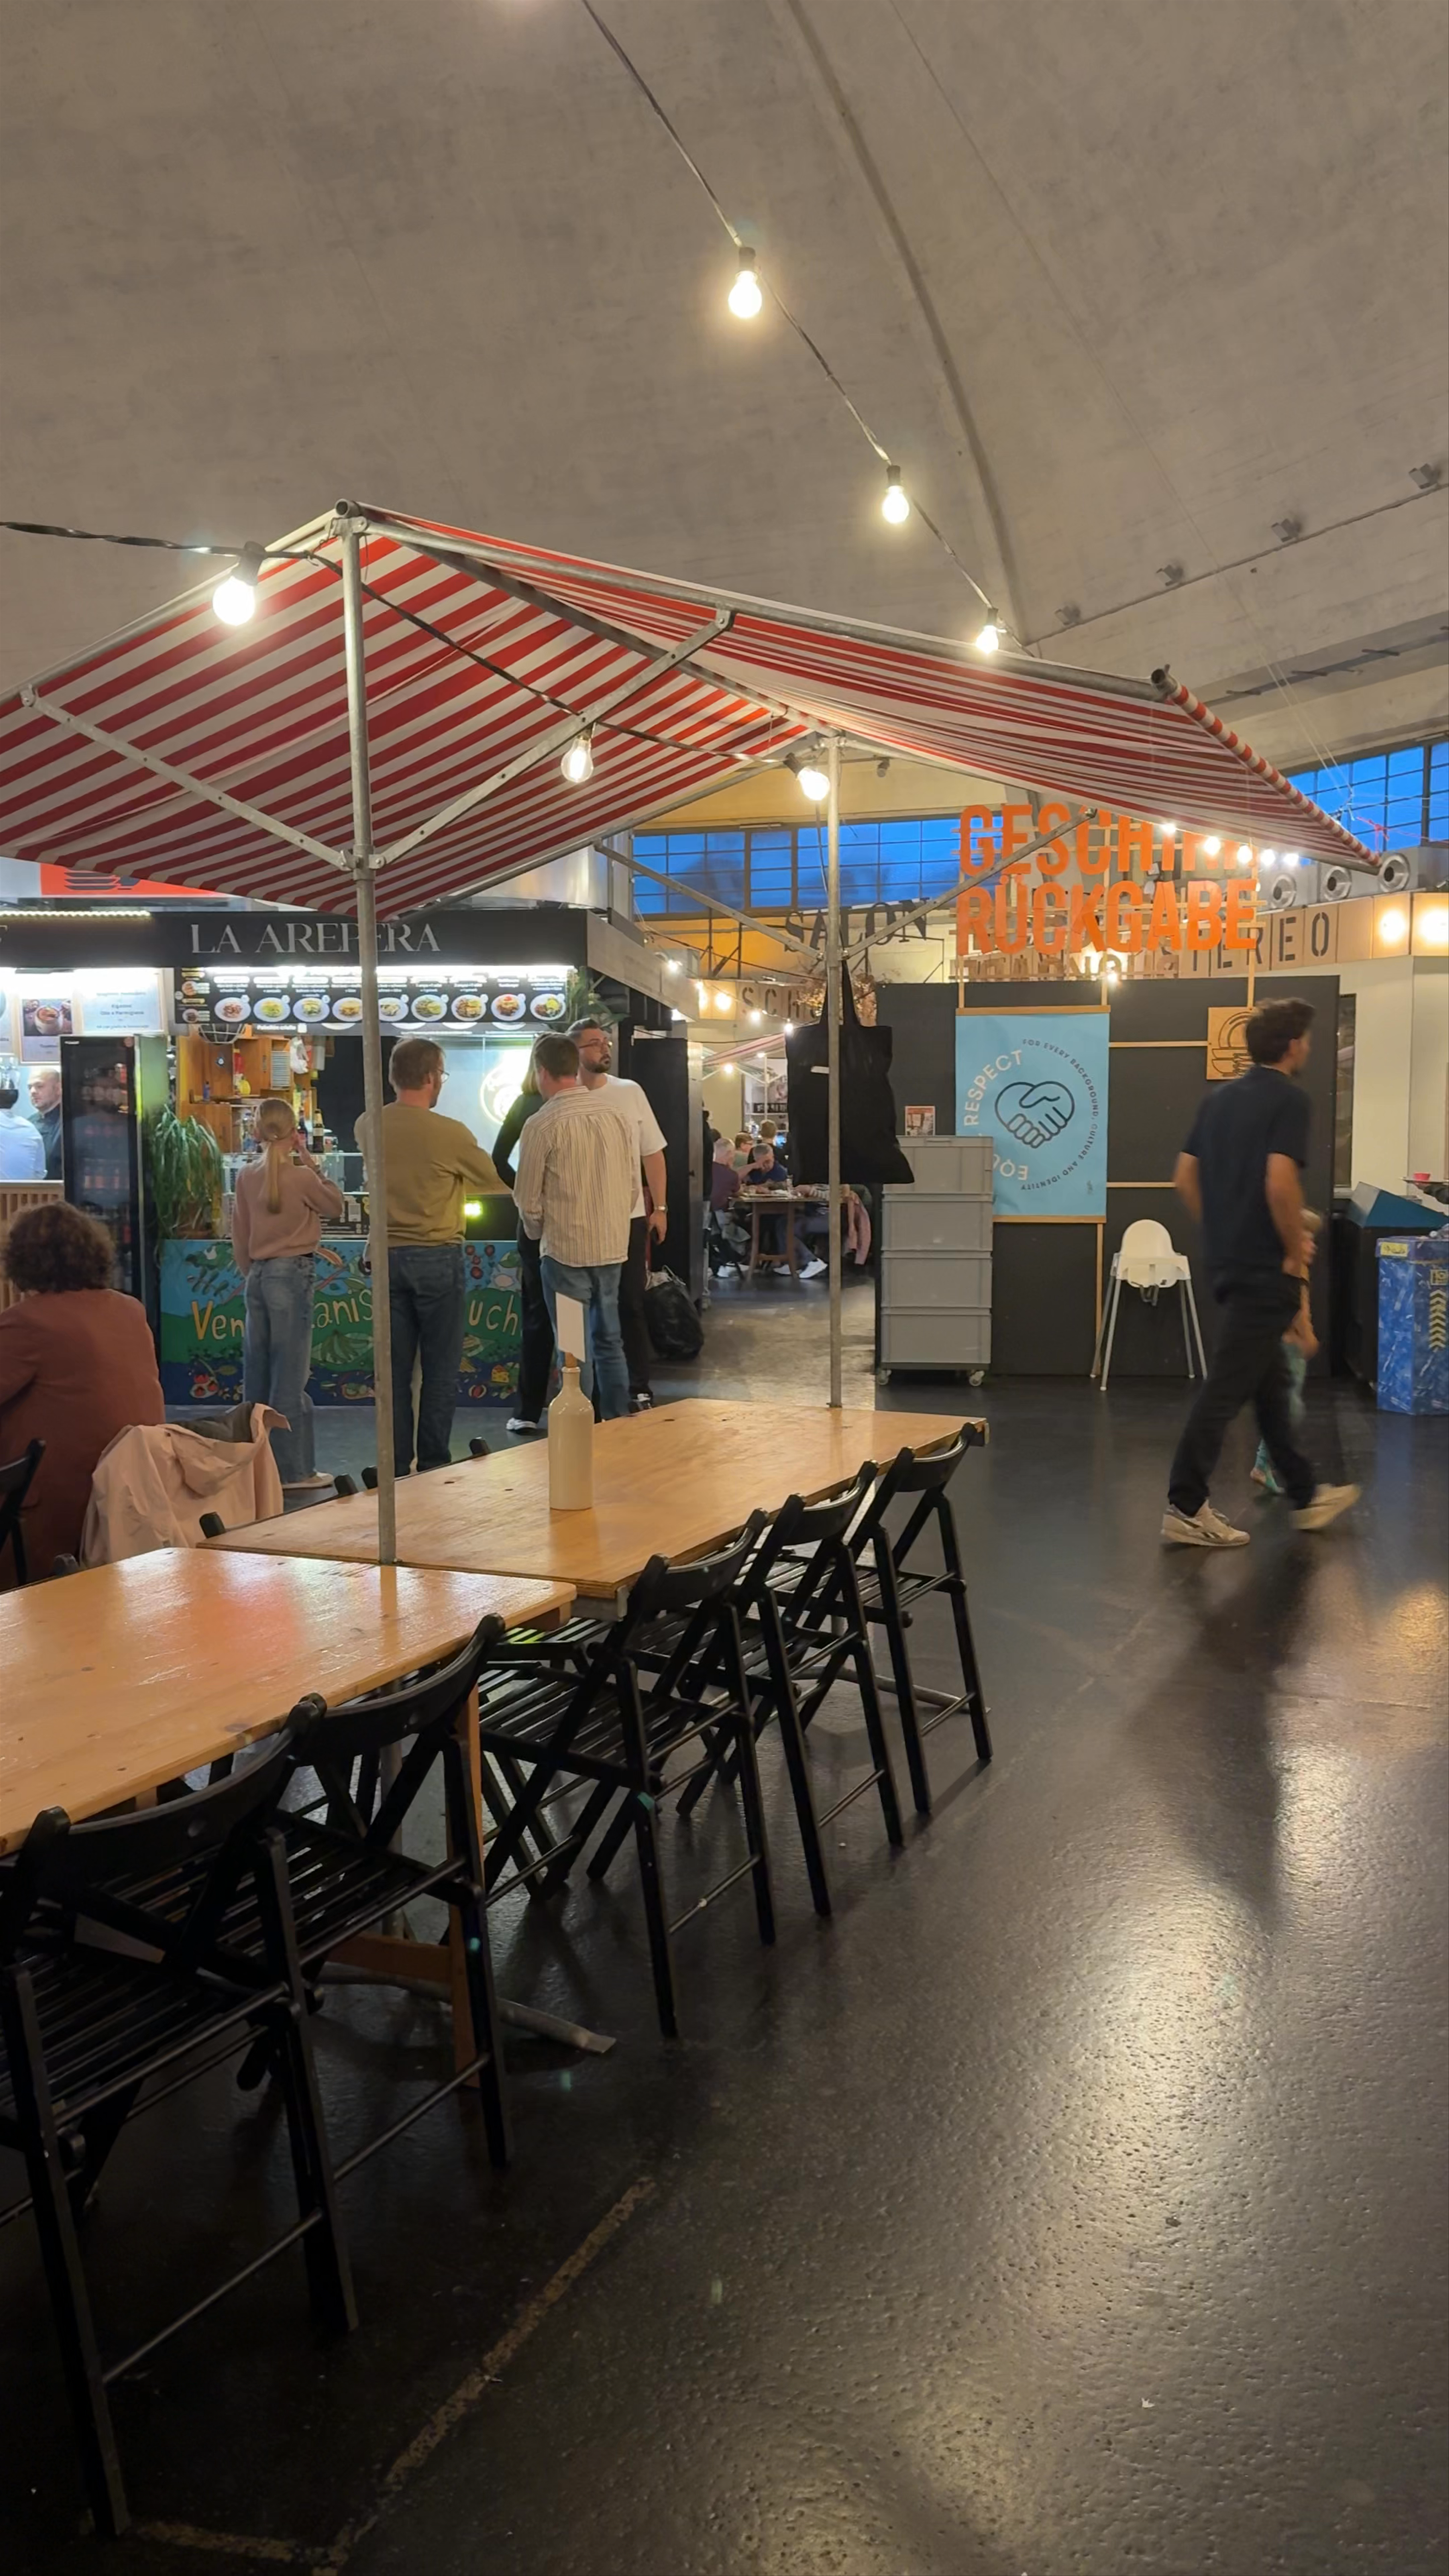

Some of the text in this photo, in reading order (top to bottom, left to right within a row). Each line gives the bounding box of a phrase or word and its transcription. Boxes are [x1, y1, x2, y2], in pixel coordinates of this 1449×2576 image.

[784, 897, 930, 952] SALON
[957, 875, 1257, 955] RÜCKGABE
[191, 924, 242, 953] LA
[1044, 1043, 1070, 1058] EVERY
[964, 1049, 1022, 1126] RESPECT
[1078, 1123, 1098, 1160] CULTURE
[1021, 1175, 1061, 1190] IDENTITY
[1062, 1161, 1078, 1175] AND
